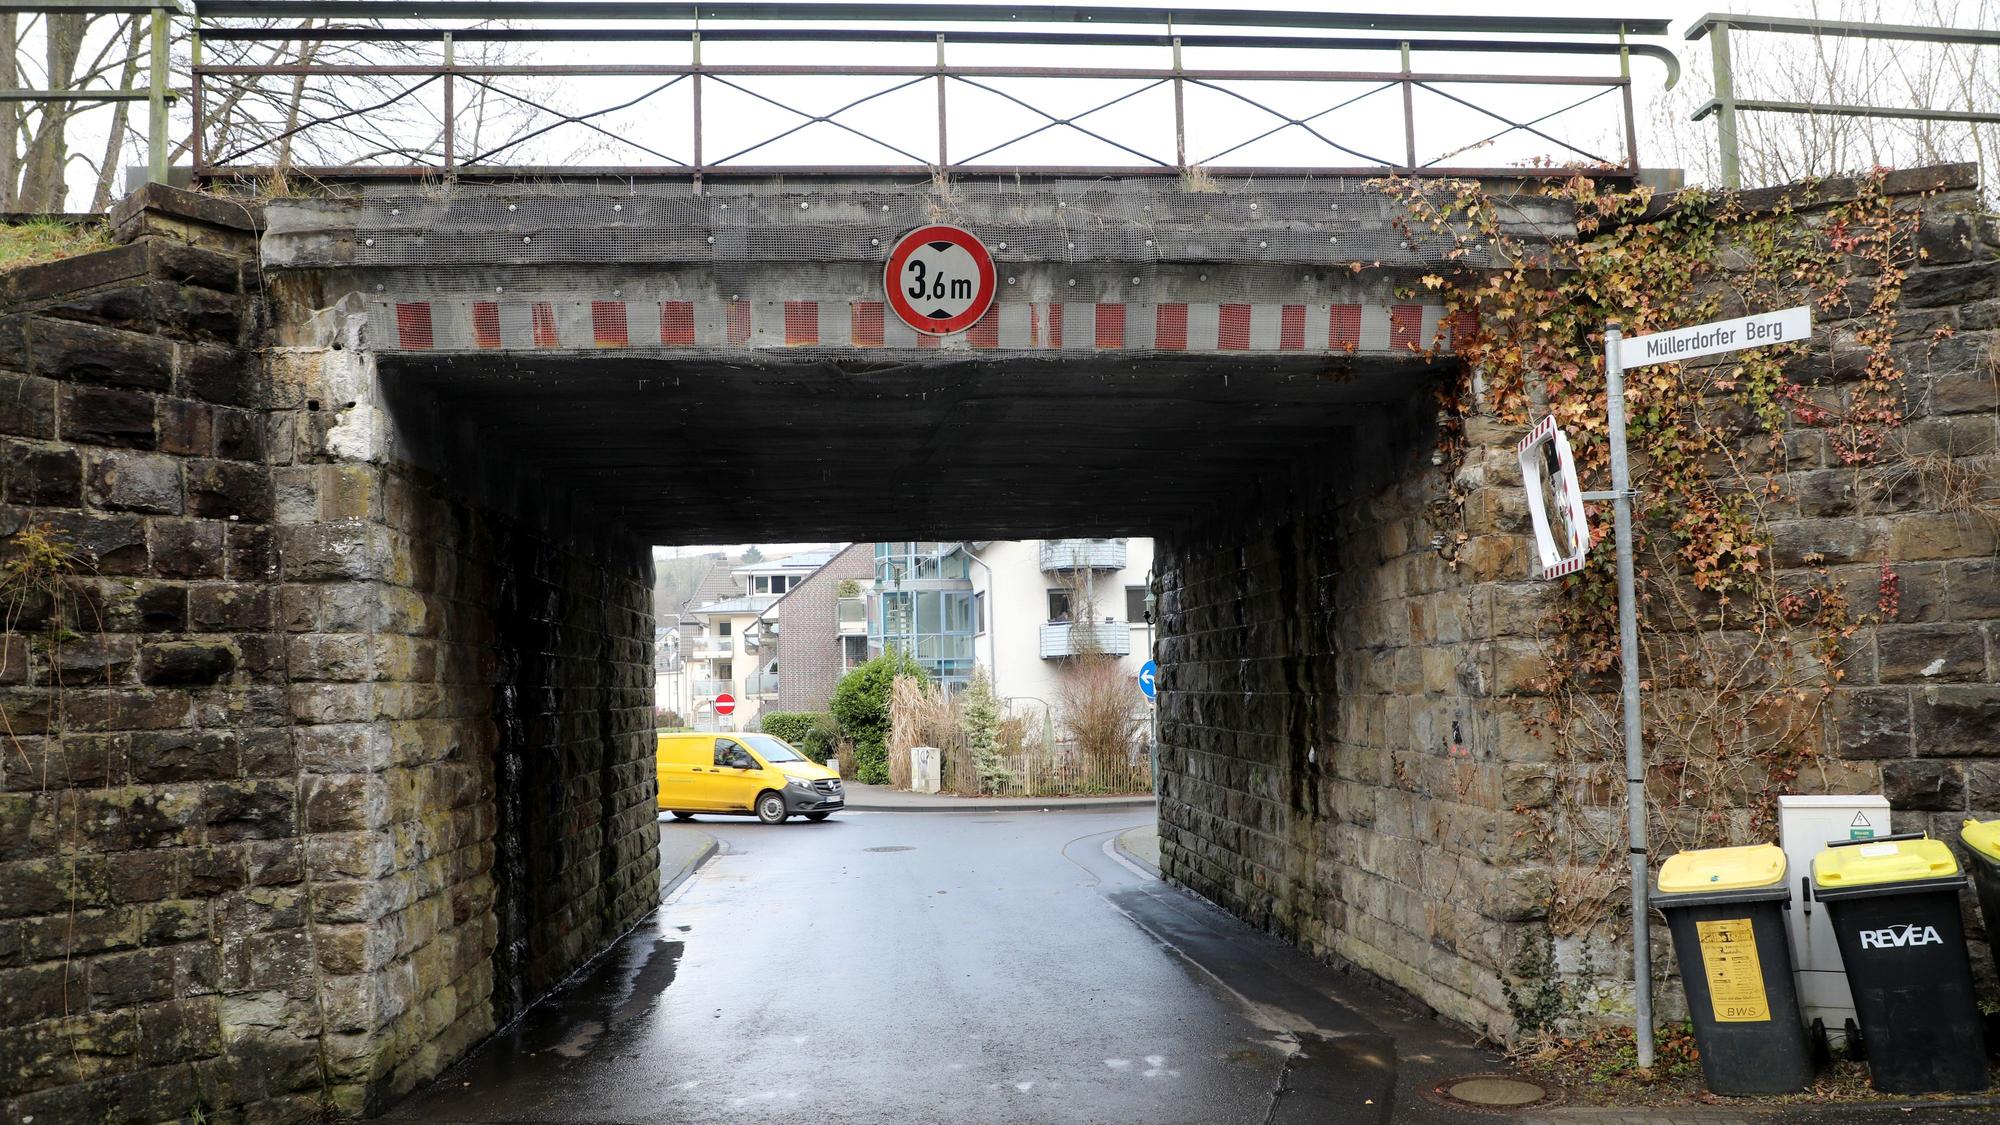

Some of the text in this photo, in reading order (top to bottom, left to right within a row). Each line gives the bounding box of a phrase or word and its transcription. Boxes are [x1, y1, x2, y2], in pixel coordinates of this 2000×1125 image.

[1647, 322, 1783, 358] Müllerdorfer Berg
[1859, 923, 1944, 949] REVEA
[1727, 1006, 1757, 1017] BWS
